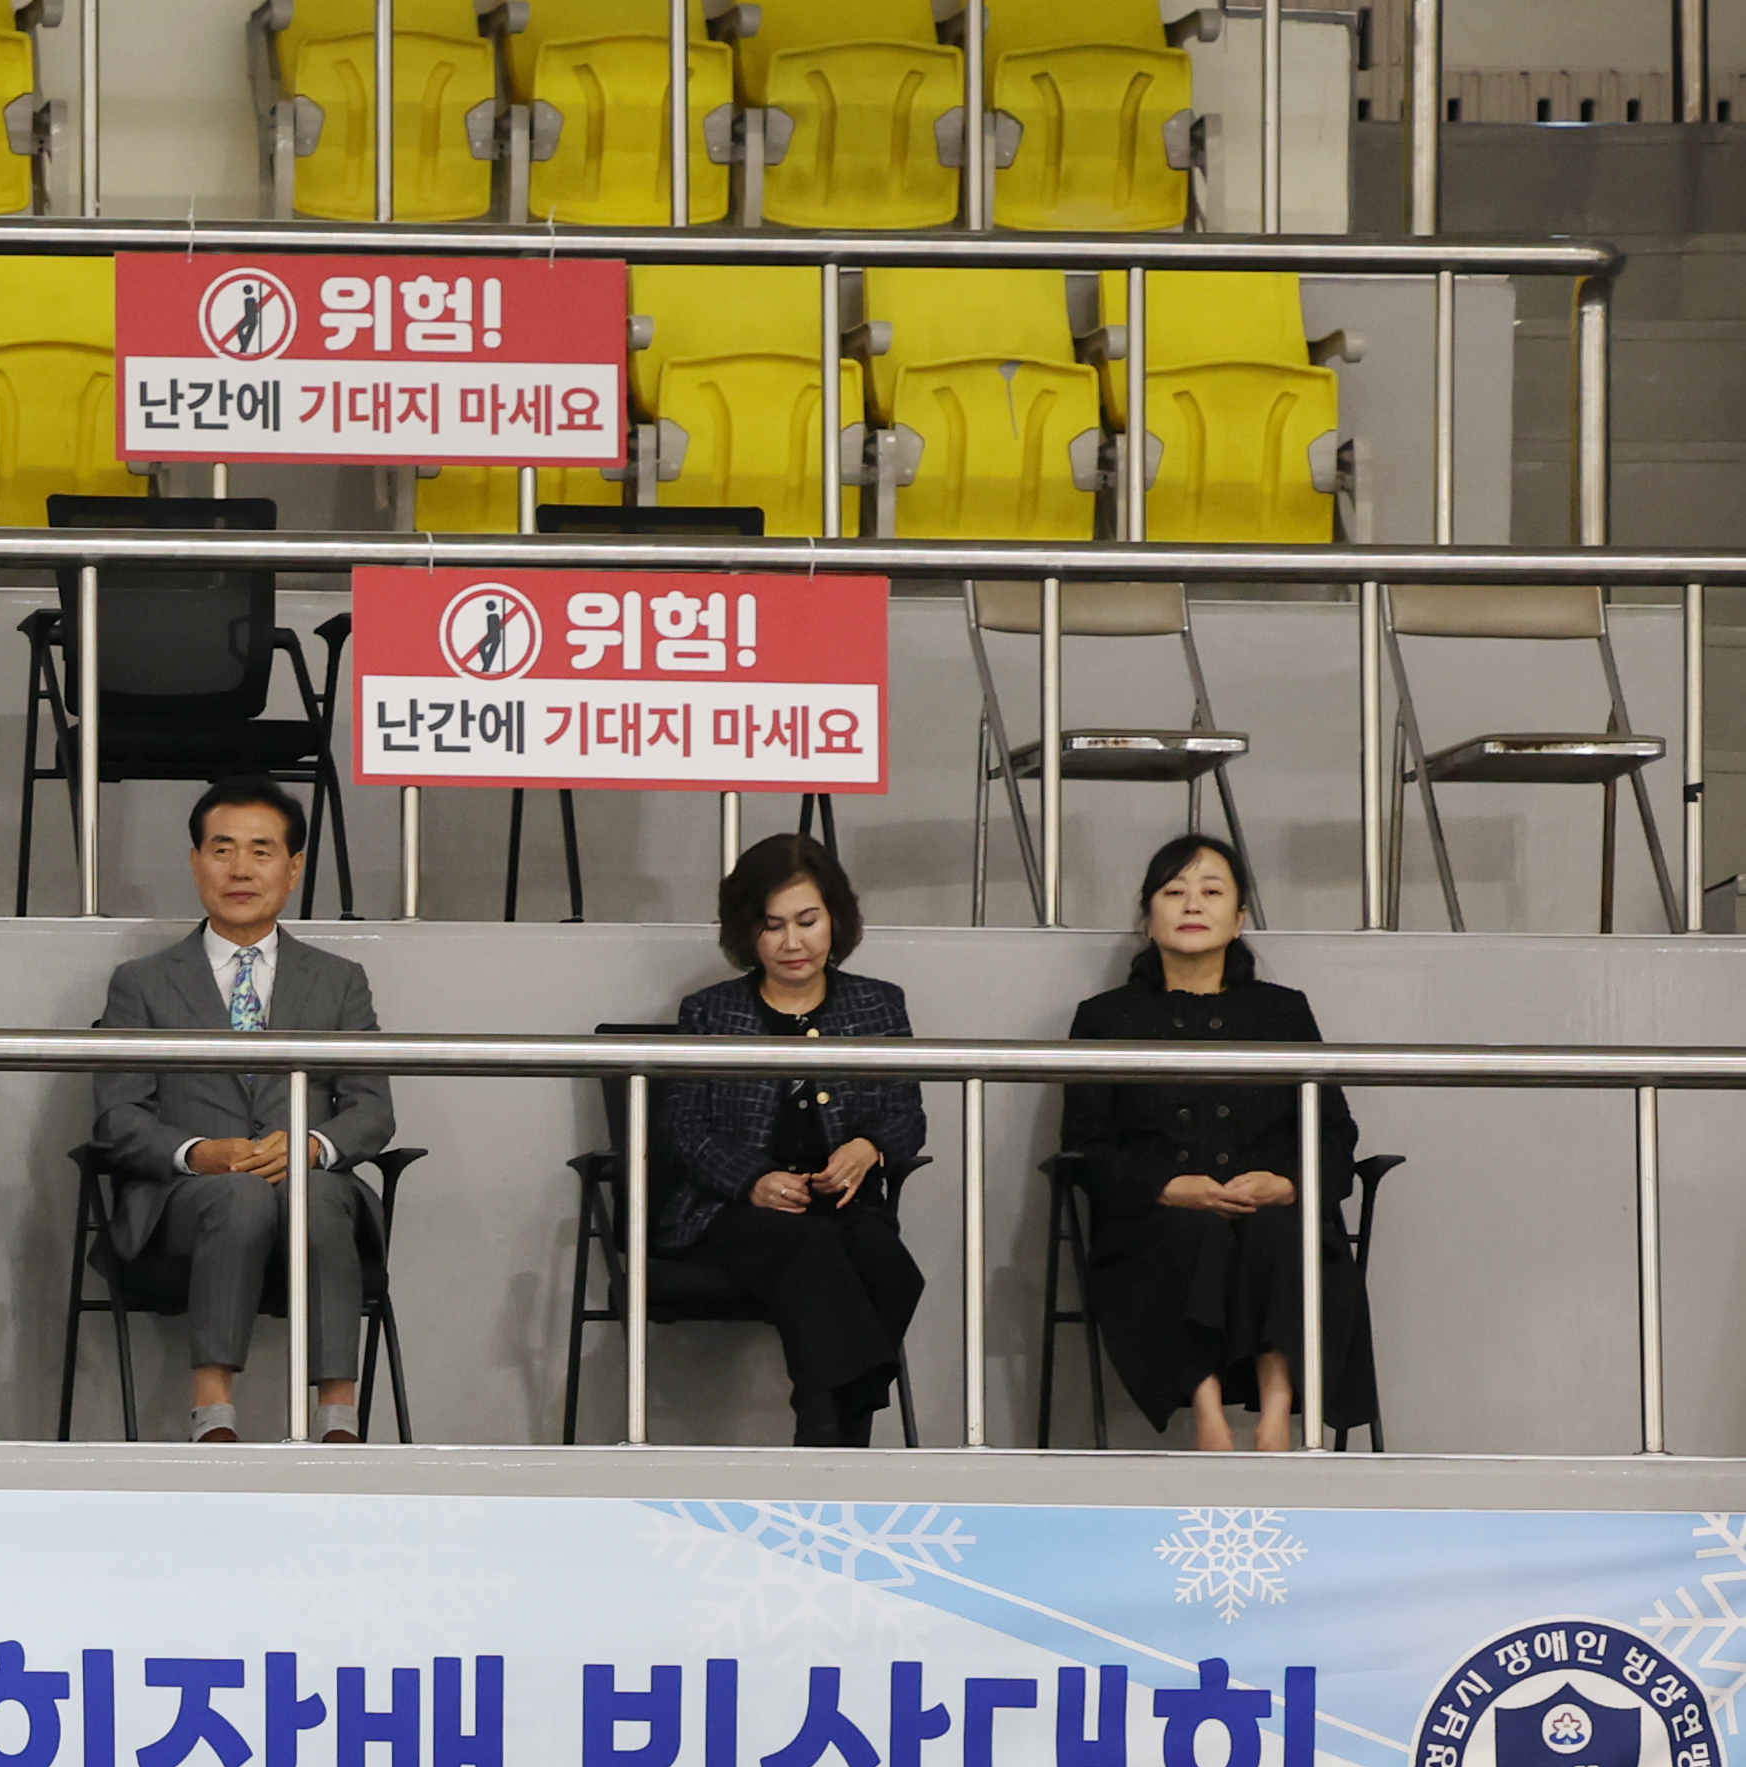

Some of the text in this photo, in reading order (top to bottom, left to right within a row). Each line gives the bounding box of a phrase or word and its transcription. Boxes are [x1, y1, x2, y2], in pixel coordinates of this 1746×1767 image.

[318, 274, 503, 353] 위험!
[137, 378, 605, 437] 난간에 기대지 마세요
[565, 590, 758, 673] 위험!
[375, 697, 864, 761] 난간에 기대지 마세요
[1494, 1629, 1608, 1676] 장애인
